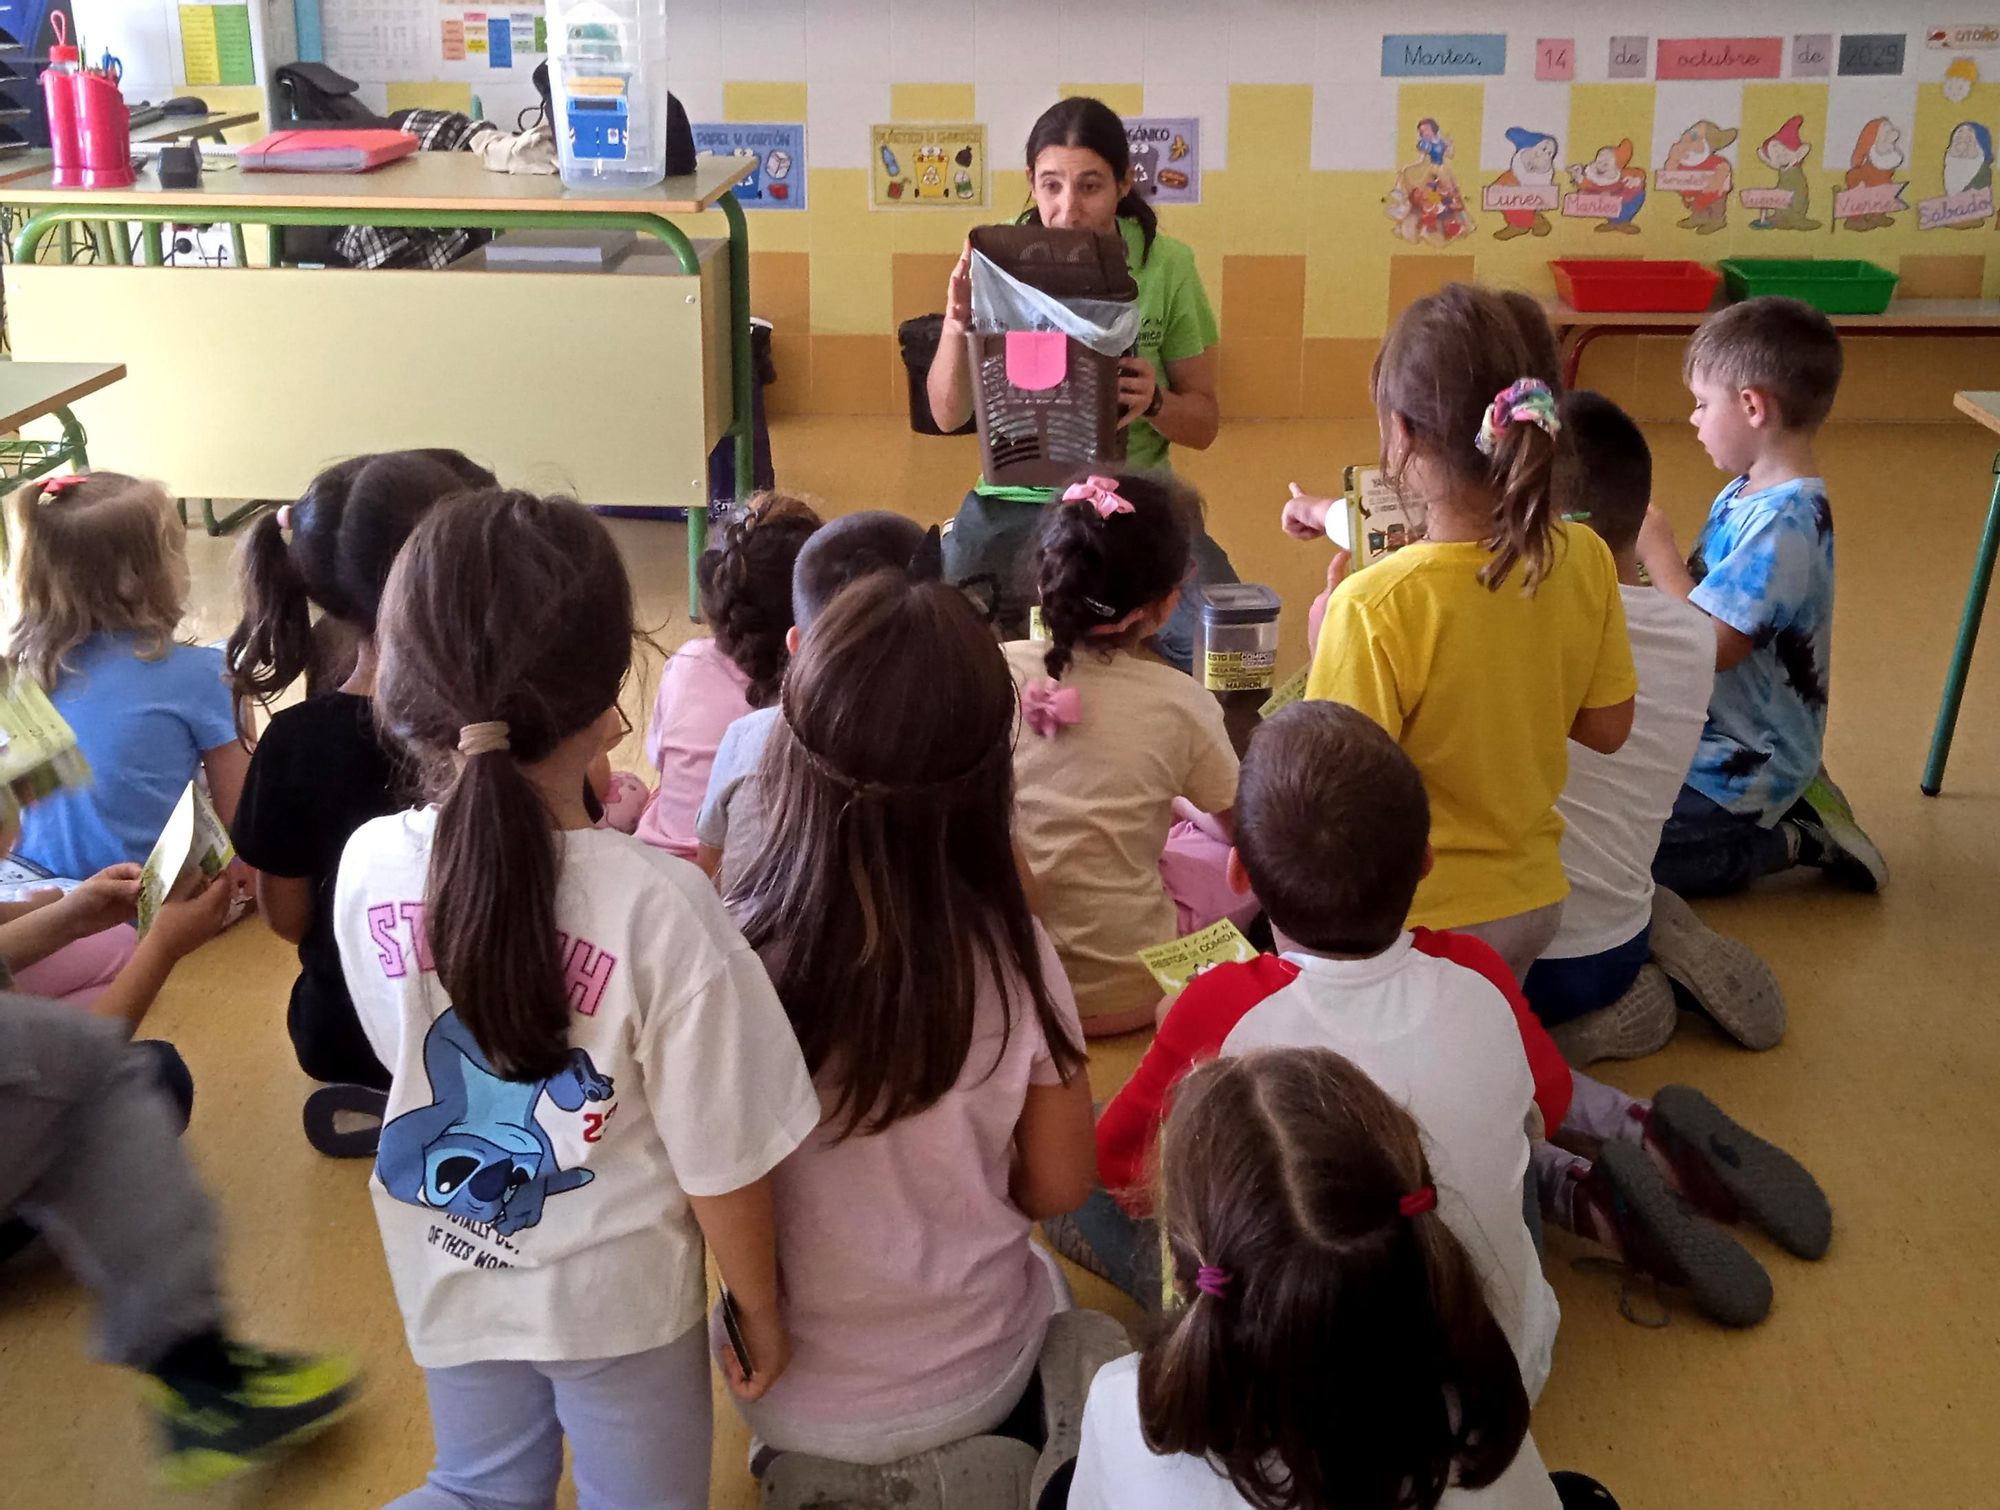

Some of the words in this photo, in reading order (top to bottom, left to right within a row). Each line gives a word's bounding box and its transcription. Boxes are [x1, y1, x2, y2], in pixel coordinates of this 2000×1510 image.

[1545, 48, 1566, 69] 14
[1614, 45, 1641, 66] de
[1677, 44, 1762, 67] octubre
[1797, 43, 1825, 64] de
[1486, 187, 1545, 206] Lunes
[1566, 195, 1619, 213] Martes
[1199, 930, 1238, 953] COMIDA
[428, 1224, 443, 1245] OF
[442, 1232, 475, 1261] THIS
